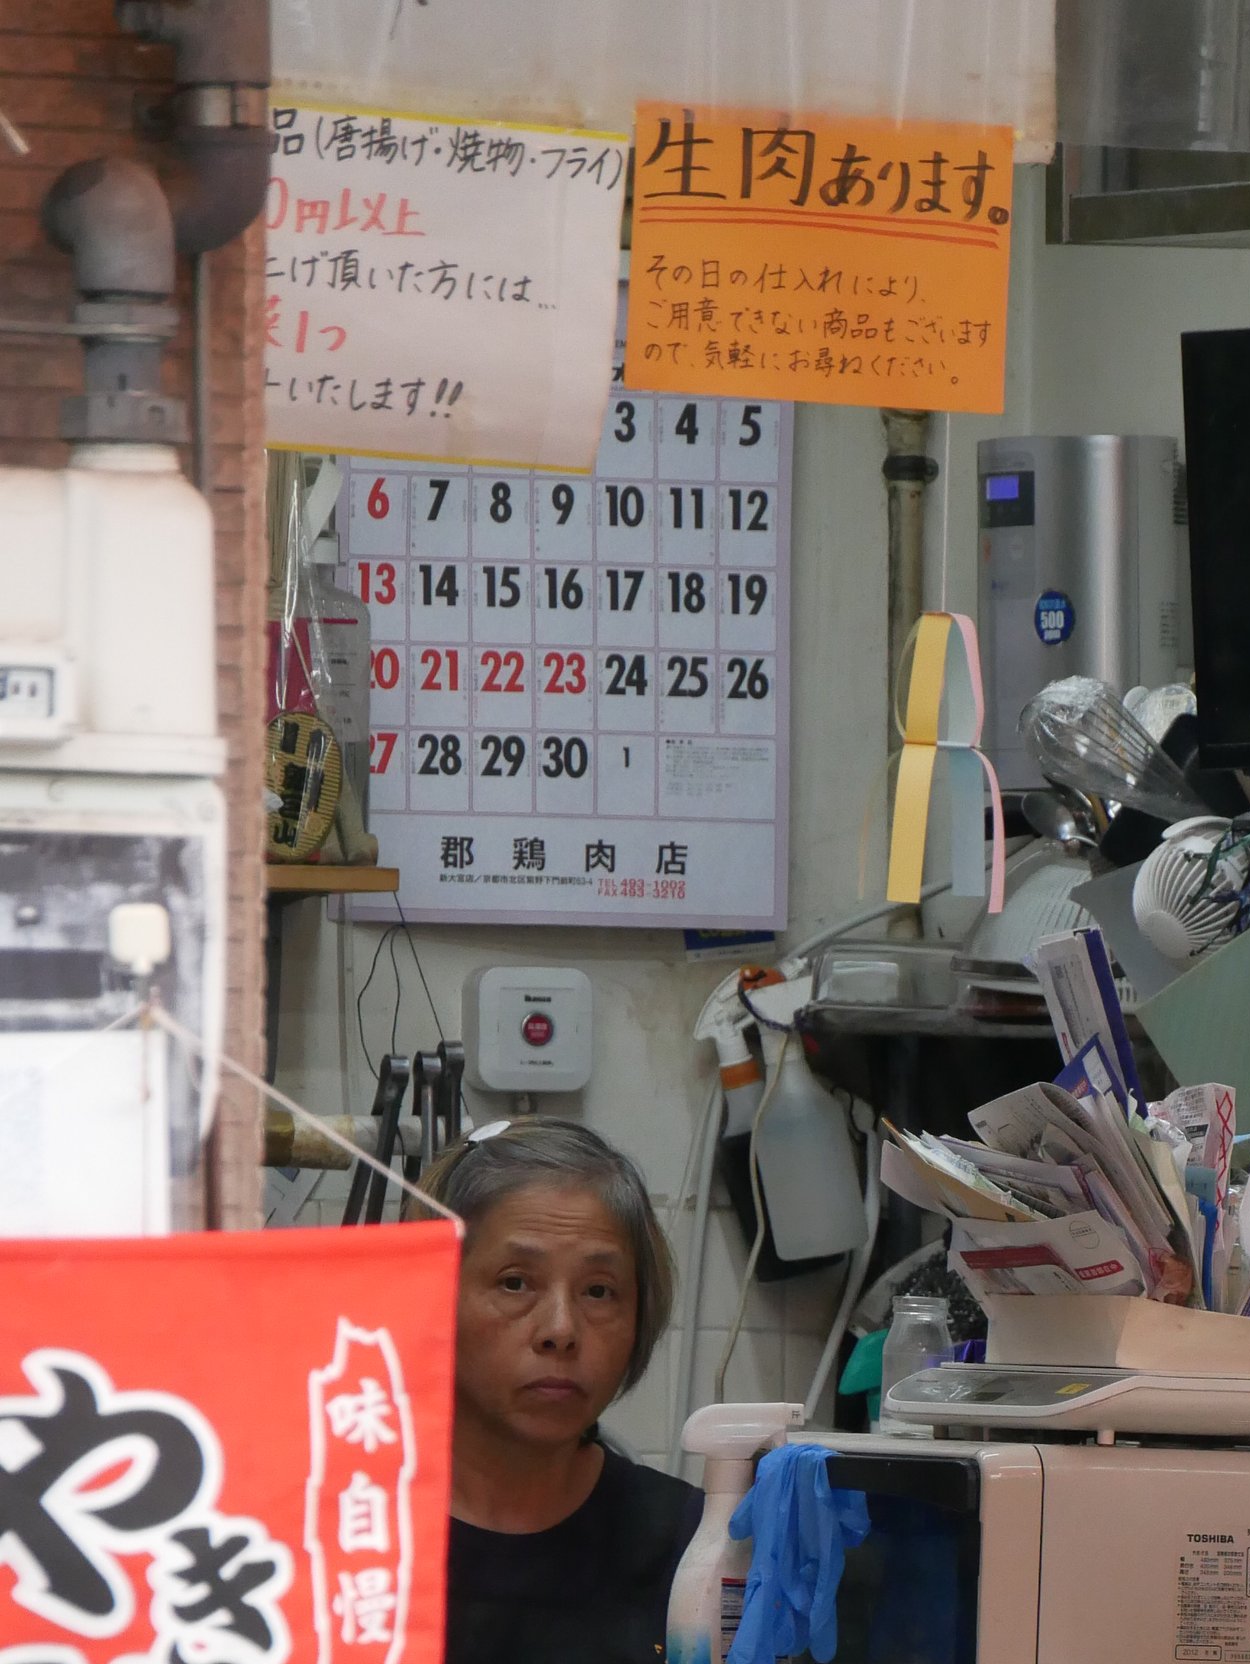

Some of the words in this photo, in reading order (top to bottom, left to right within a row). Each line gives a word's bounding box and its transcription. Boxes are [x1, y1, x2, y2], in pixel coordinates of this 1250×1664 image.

[642, 109, 1010, 225] 生肉あります。
[614, 401, 636, 442] 3
[675, 403, 698, 444] 4
[739, 405, 762, 446] 5
[367, 478, 389, 519] 6
[428, 480, 450, 521] 7
[489, 481, 512, 523] 8
[552, 483, 575, 525] 9
[605, 485, 644, 527] 10
[669, 487, 704, 529] 11
[729, 489, 769, 531] 12
[357, 562, 396, 604] 13
[419, 564, 459, 606] 14
[482, 566, 521, 608] 15
[544, 568, 584, 610] 16
[605, 570, 645, 612] 17
[667, 571, 706, 613] 18
[728, 573, 768, 615] 19
[420, 649, 459, 692] 21
[480, 650, 525, 693] 22
[543, 651, 587, 694] 23
[605, 653, 648, 696] 24
[667, 656, 709, 698] 25
[727, 657, 769, 699] 26
[417, 733, 462, 776] 28
[481, 734, 526, 777] 29
[542, 736, 588, 779] 30
[622, 746, 632, 769] 1
[327, 1376, 400, 1647] 味自慢
[1187, 1533, 1234, 1544] TOSHIBA
